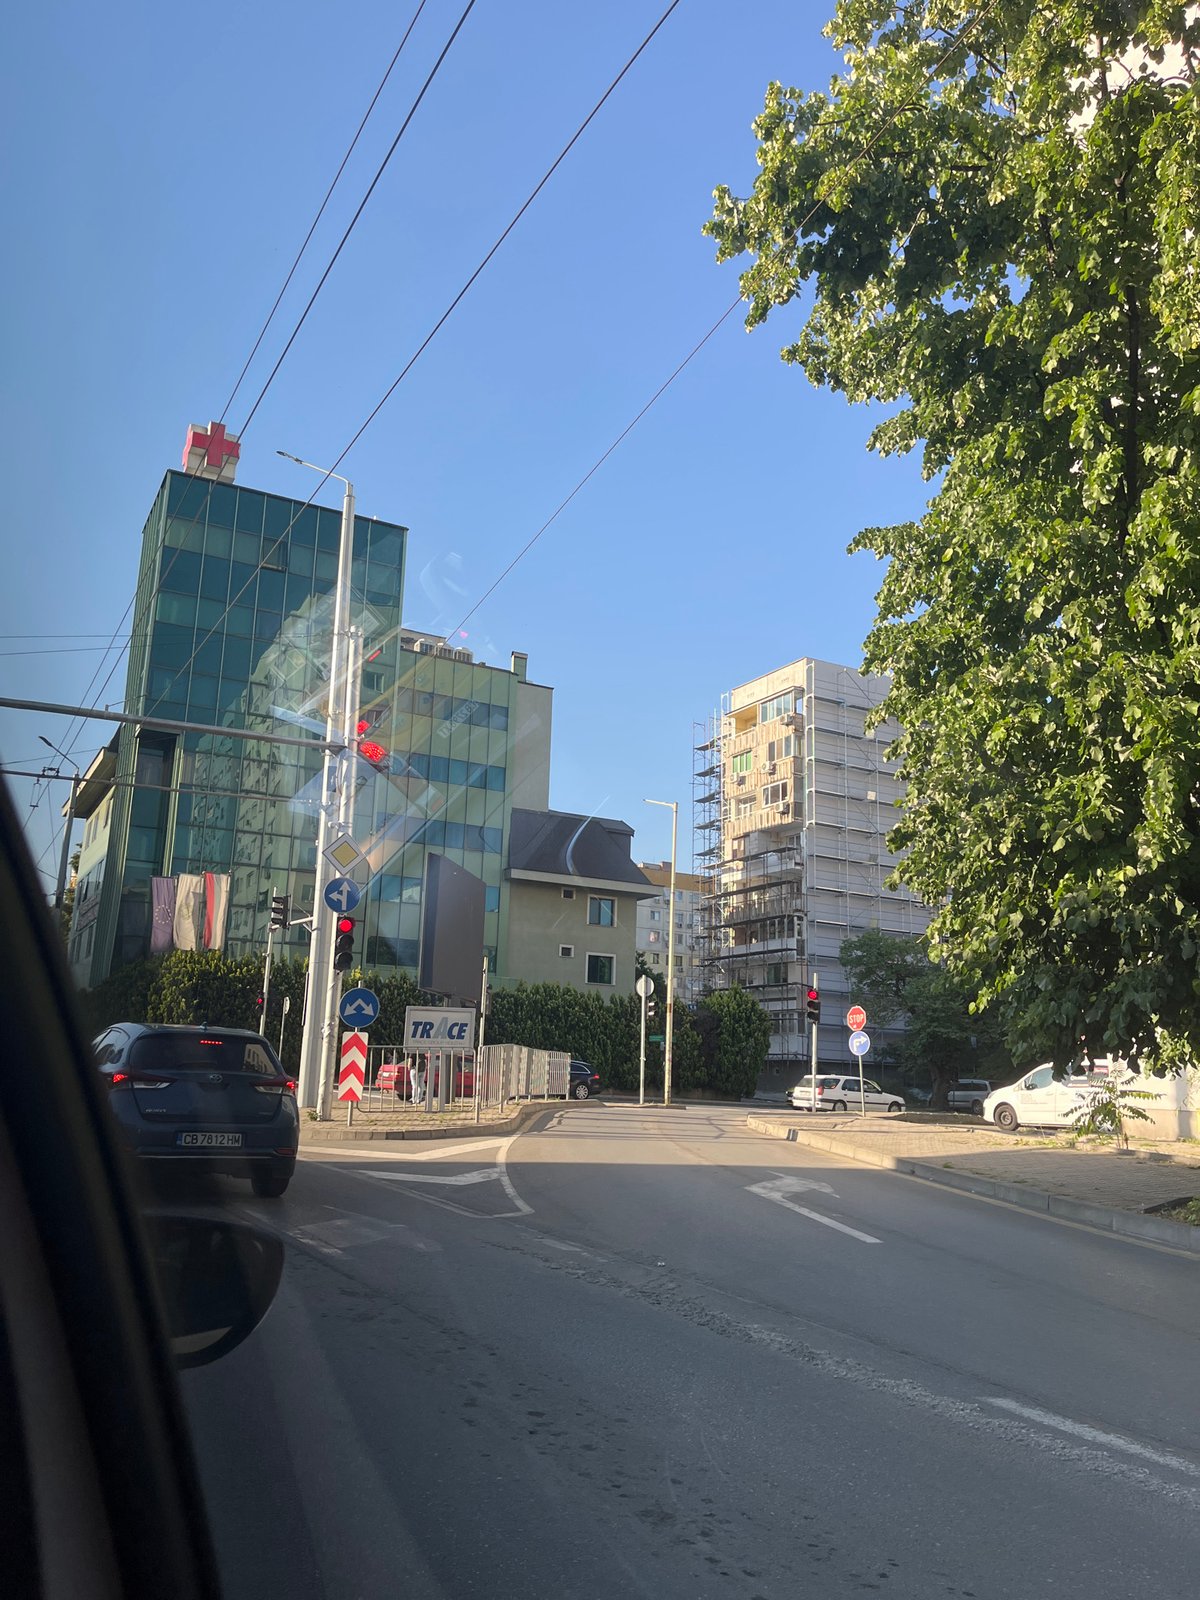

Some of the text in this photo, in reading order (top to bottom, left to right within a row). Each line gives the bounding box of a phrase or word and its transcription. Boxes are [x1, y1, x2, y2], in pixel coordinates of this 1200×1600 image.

[850, 1014, 864, 1023] STOP
[411, 1017, 468, 1040] TRACE
[183, 1134, 198, 1145] CB
[227, 1134, 241, 1145] HM
